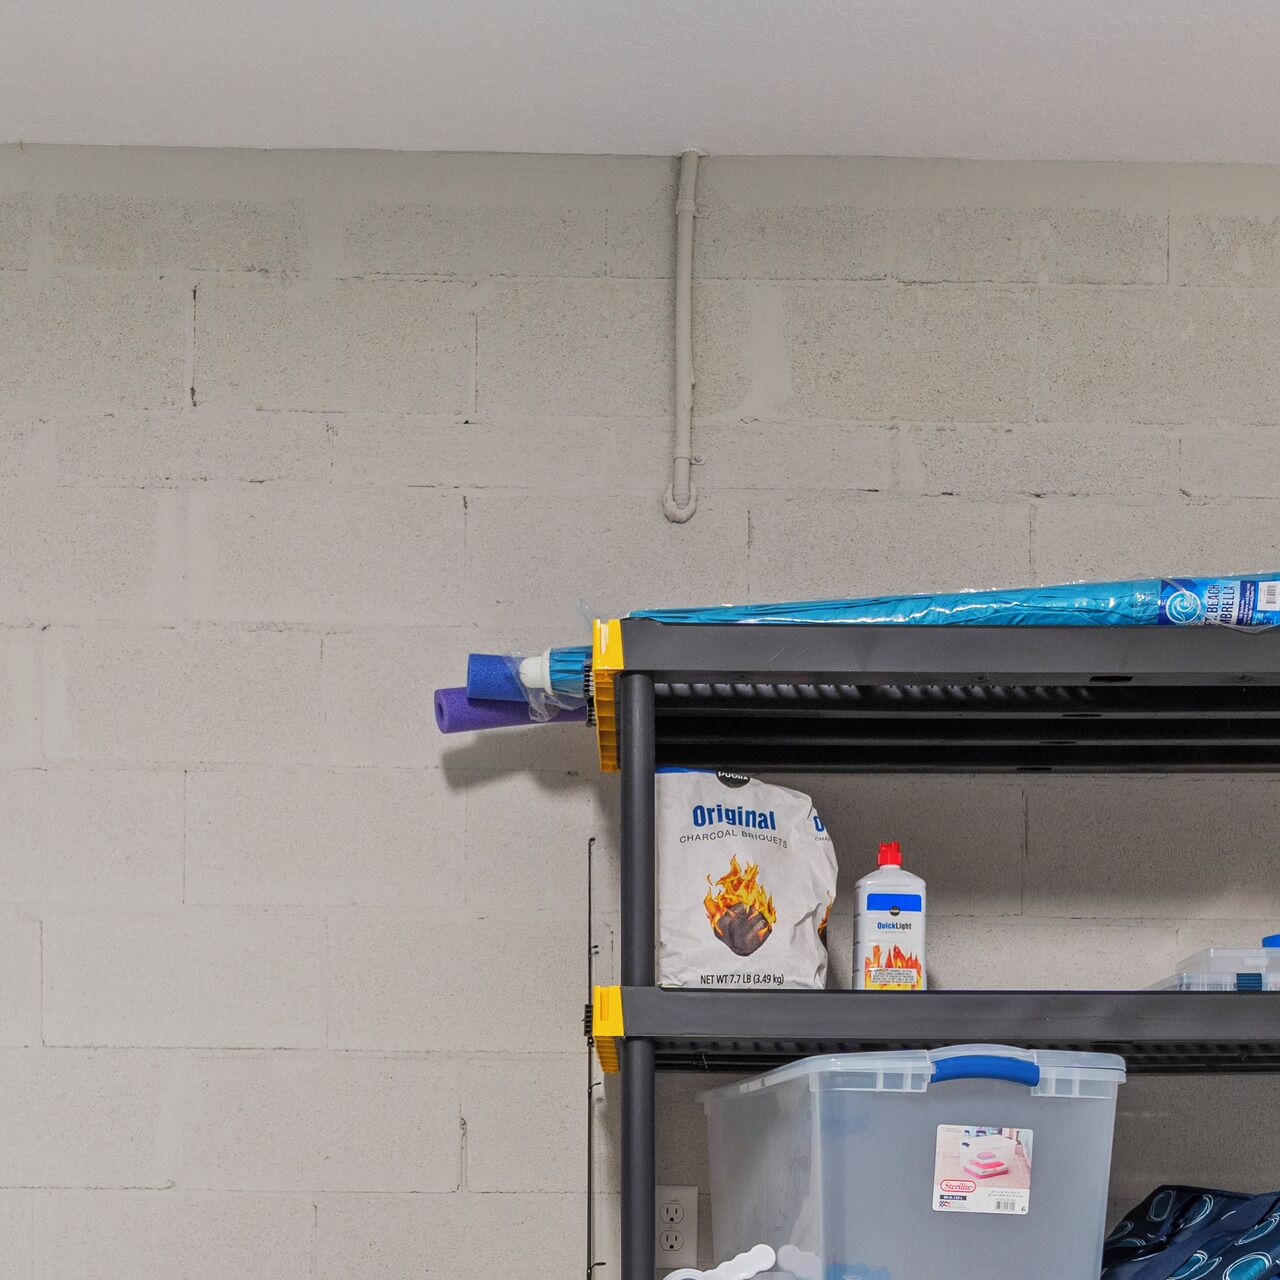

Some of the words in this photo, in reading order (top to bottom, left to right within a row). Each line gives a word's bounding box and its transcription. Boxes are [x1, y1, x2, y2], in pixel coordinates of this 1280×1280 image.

[1206, 584, 1221, 613] BEACH
[692, 804, 776, 831] Original
[679, 829, 738, 844] CHARCOAL
[741, 830, 788, 849] BRIQUETS
[700, 974, 715, 984] NET
[716, 974, 729, 984] WT
[729, 974, 741, 984] 7.7
[742, 974, 752, 984] LB
[753, 974, 772, 984] (3.49
[772, 974, 784, 986] kg)
